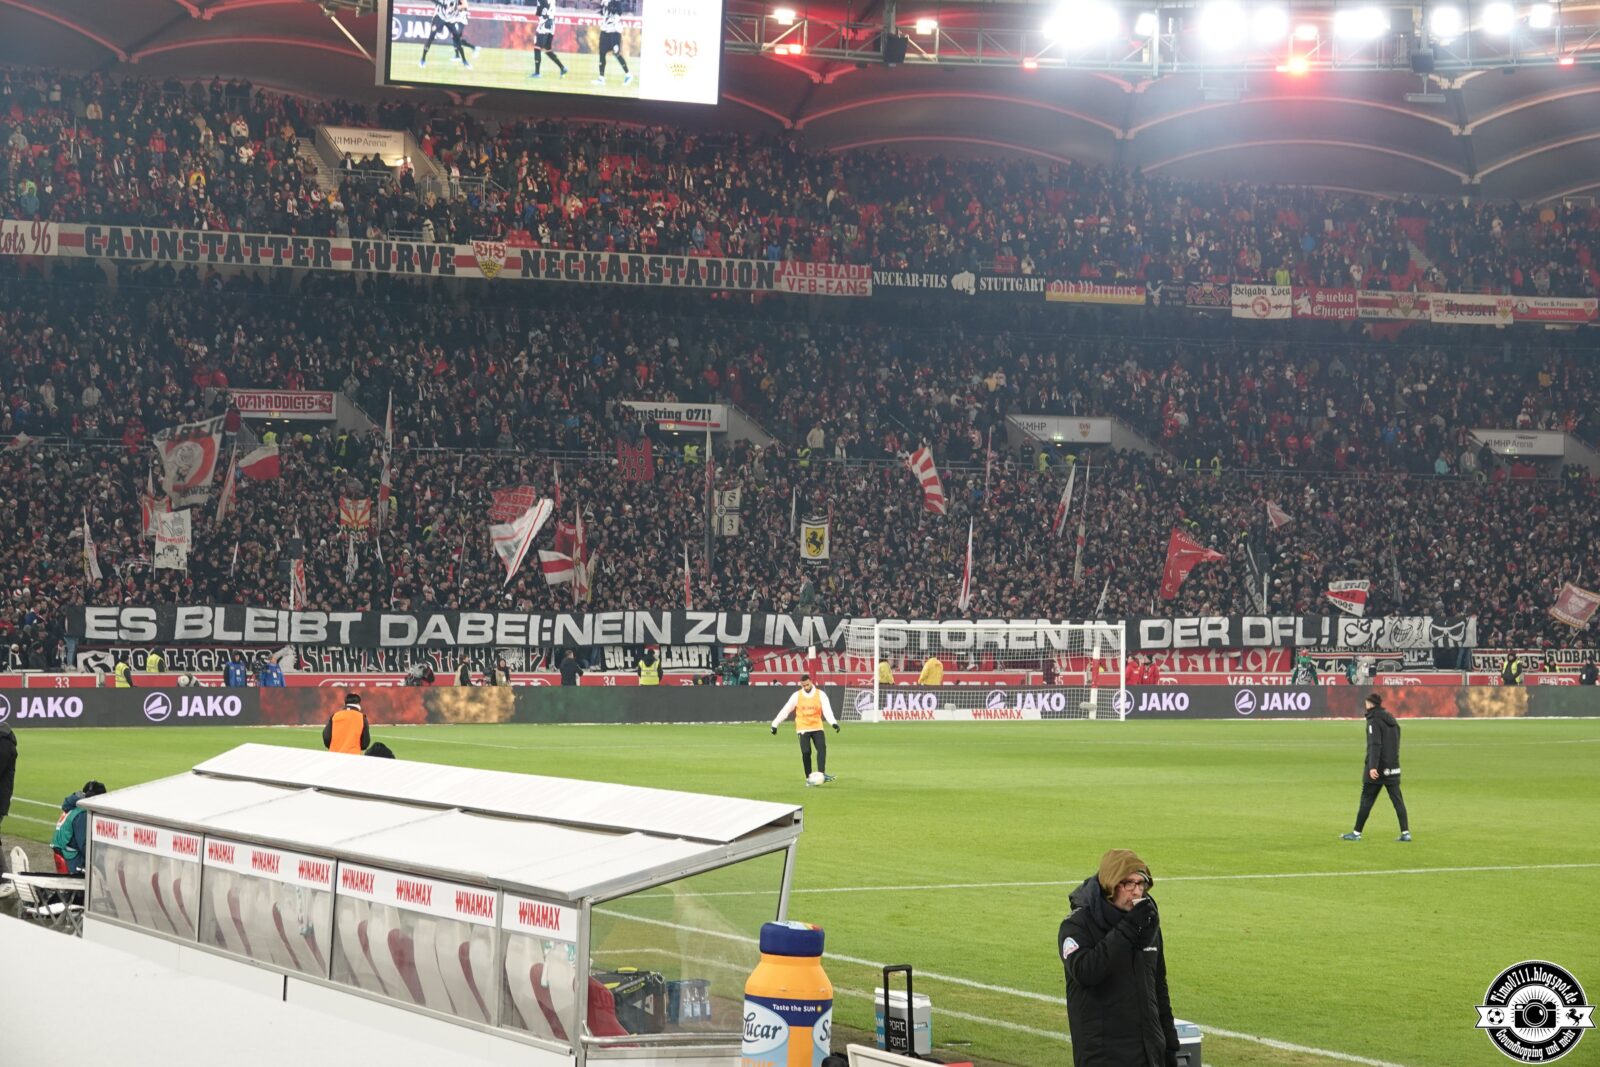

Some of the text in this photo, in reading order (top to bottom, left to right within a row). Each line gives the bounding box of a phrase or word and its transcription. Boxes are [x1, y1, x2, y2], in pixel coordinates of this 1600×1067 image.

[343, 136, 387, 147] MHP Arena
[31, 221, 51, 254] 96
[84, 225, 456, 276] CANNSTATTER KURVE
[520, 249, 775, 289] NECKARSTADION
[784, 263, 872, 278] ALBSTADT
[786, 277, 868, 295] VFB-FANS
[873, 271, 1046, 292] NECKAR-FILS STUTTGART
[1050, 279, 1137, 298] Old Warriors
[1026, 422, 1047, 431] MHP
[85, 606, 157, 641] ES
[174, 606, 363, 645] BLEIBT
[685, 611, 751, 643] ZU
[1139, 616, 1230, 649] DER
[1241, 615, 1330, 648] DFL!
[1246, 648, 1286, 673] 97
[16, 696, 84, 719] JAKO
[177, 695, 242, 717] JAKO
[883, 692, 937, 711] JAKO
[1013, 692, 1066, 711] JAKO
[1138, 692, 1190, 712] JAKO
[1260, 692, 1311, 711] JAKO
[882, 710, 935, 720] WINAMAX
[972, 709, 1023, 719] WINAMAX
[96, 818, 120, 840] WINAMAX
[133, 826, 158, 848] WINAMAX
[172, 834, 198, 856] WINAMAX
[208, 840, 235, 865] WINAMAX
[251, 850, 281, 874] WINAMAX
[297, 858, 331, 884] WINAMAX
[342, 867, 375, 895] WINAMAX
[396, 879, 432, 907] WINAMAX
[455, 890, 494, 919] WINAMAX
[518, 900, 561, 931] WINAMAX
[772, 1003, 789, 1011] Taste
[791, 1004, 802, 1012] the
